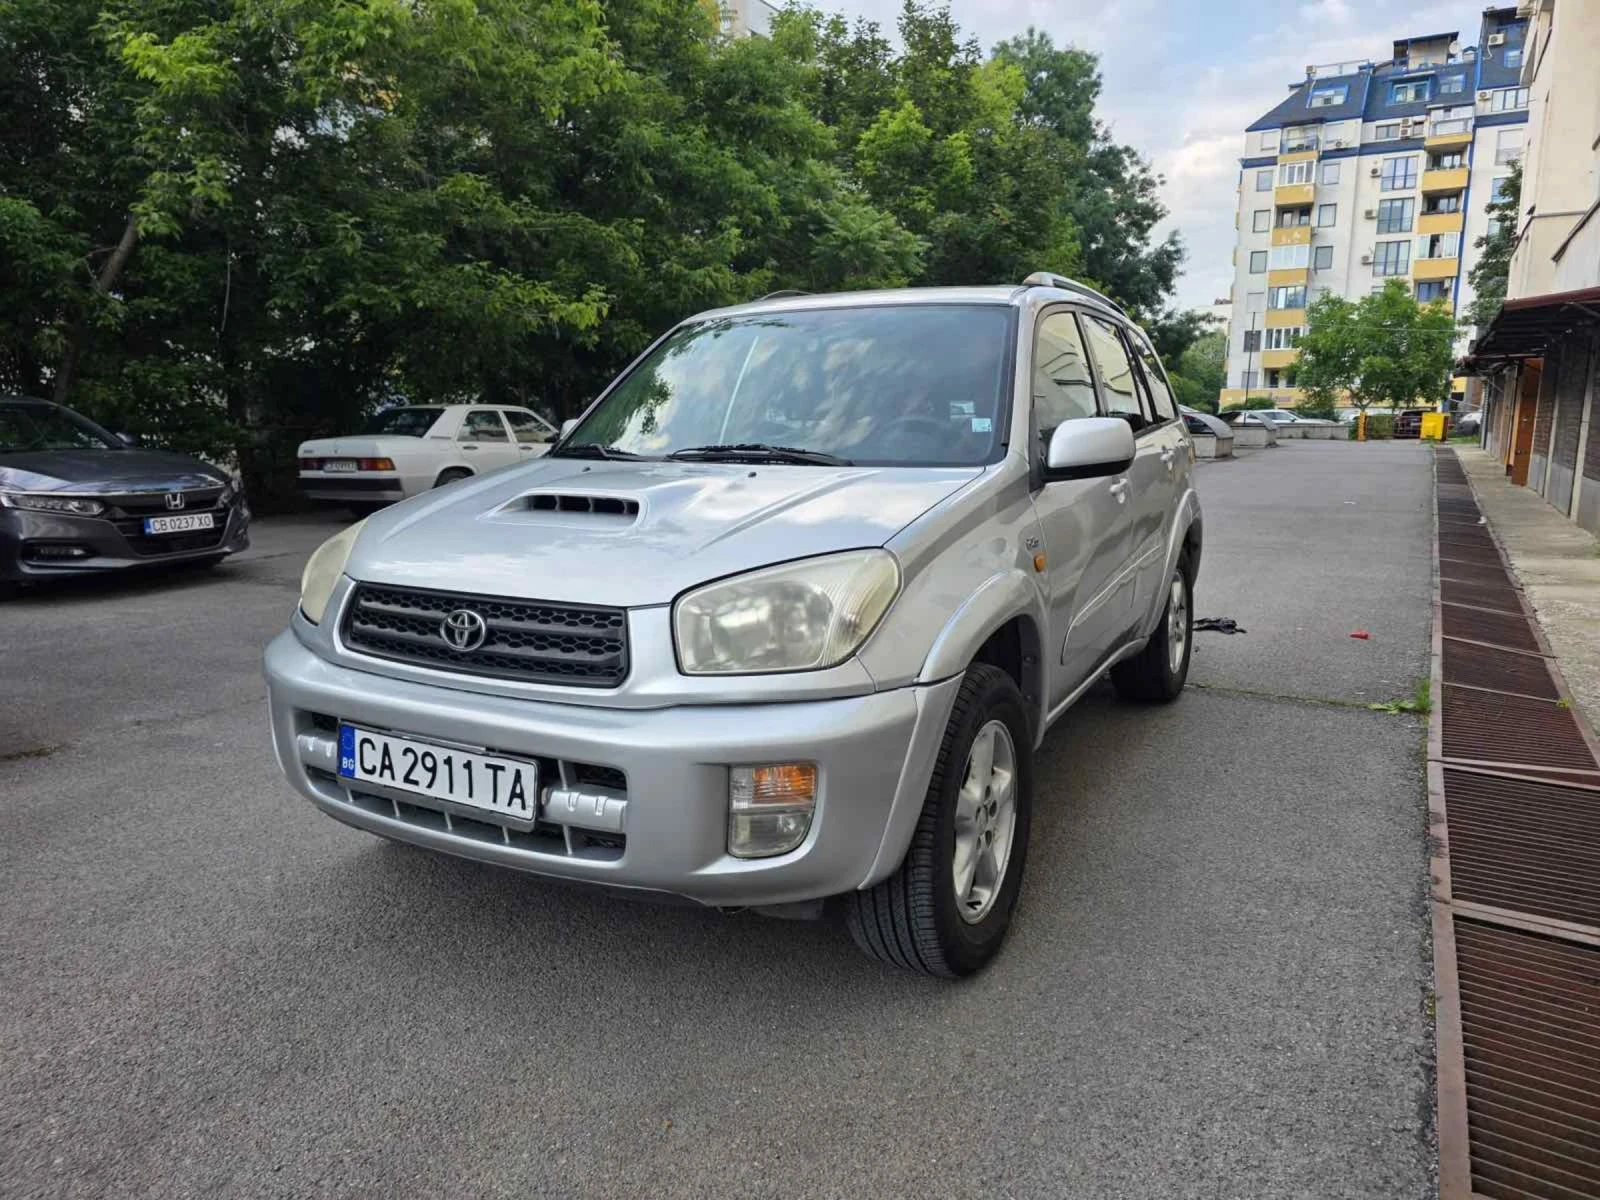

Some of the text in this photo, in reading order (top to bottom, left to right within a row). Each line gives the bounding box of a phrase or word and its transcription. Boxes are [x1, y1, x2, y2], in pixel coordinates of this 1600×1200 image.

[152, 519, 168, 531] CB
[169, 516, 195, 530] 0237
[342, 756, 354, 770] BG
[359, 737, 527, 811] CA 2911 TA
